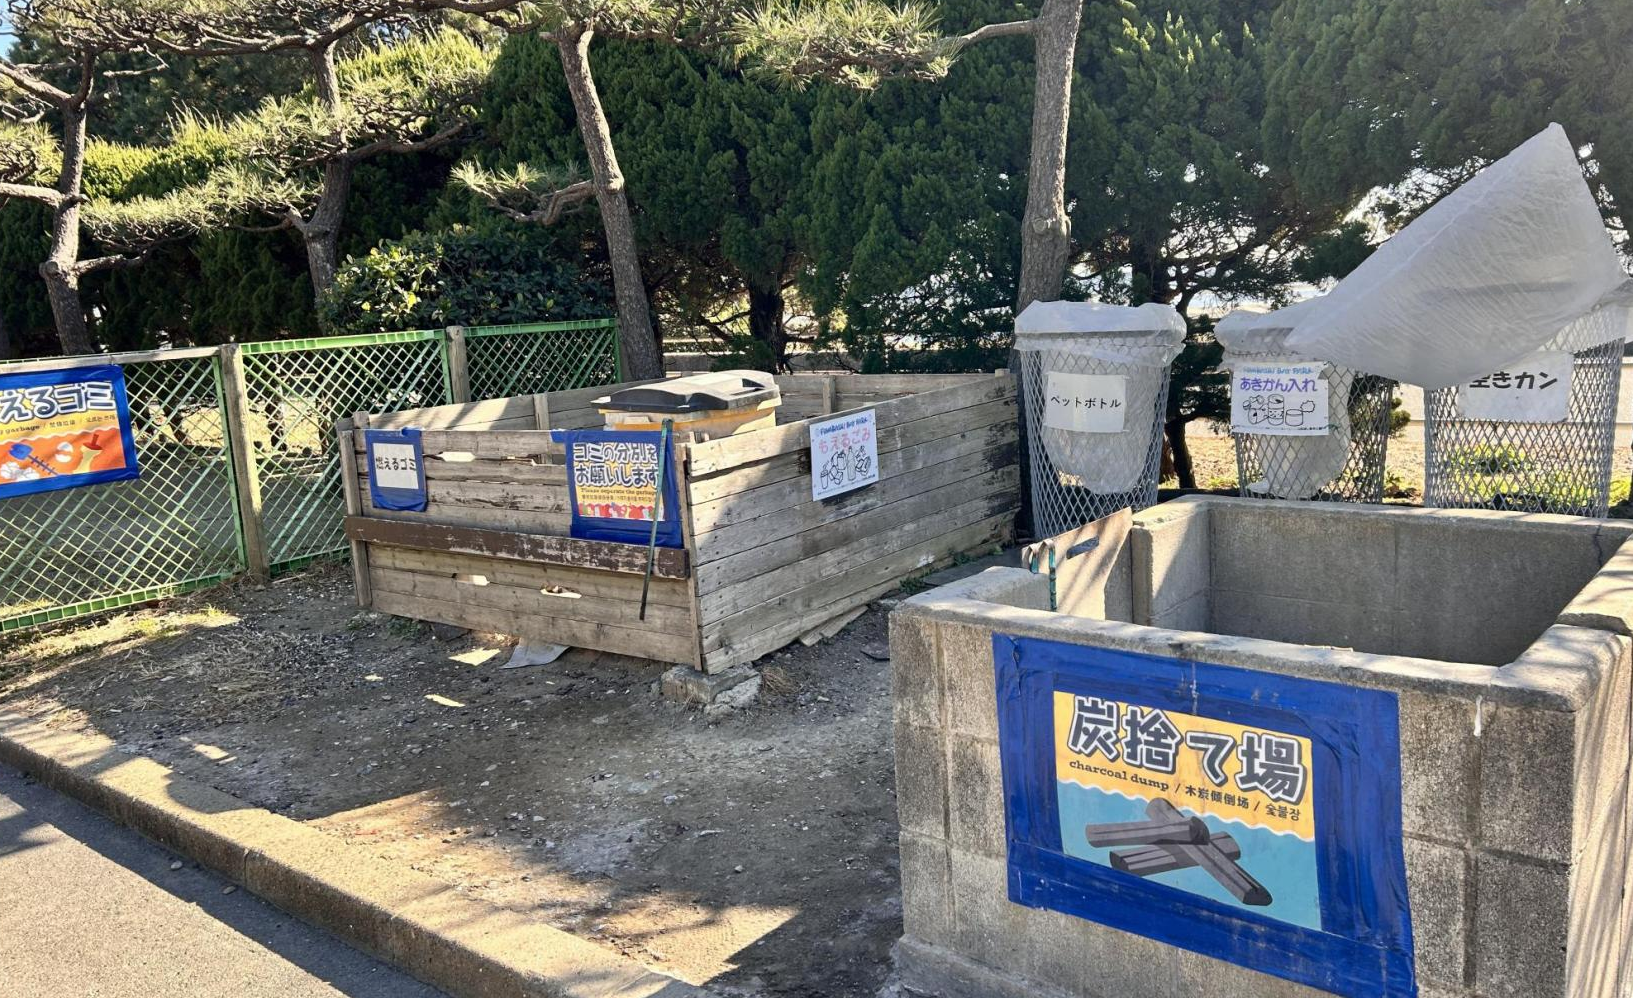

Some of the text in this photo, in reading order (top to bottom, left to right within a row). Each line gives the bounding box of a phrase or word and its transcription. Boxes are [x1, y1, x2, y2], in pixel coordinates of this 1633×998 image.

[1240, 378, 1318, 393] あきかん入れ
[1050, 396, 1122, 409] ペットボトル
[575, 463, 658, 490] お願いします
[1067, 694, 1308, 805] 炭捨て場
[1069, 760, 1128, 781] charcoal
[1131, 773, 1169, 792] dump
